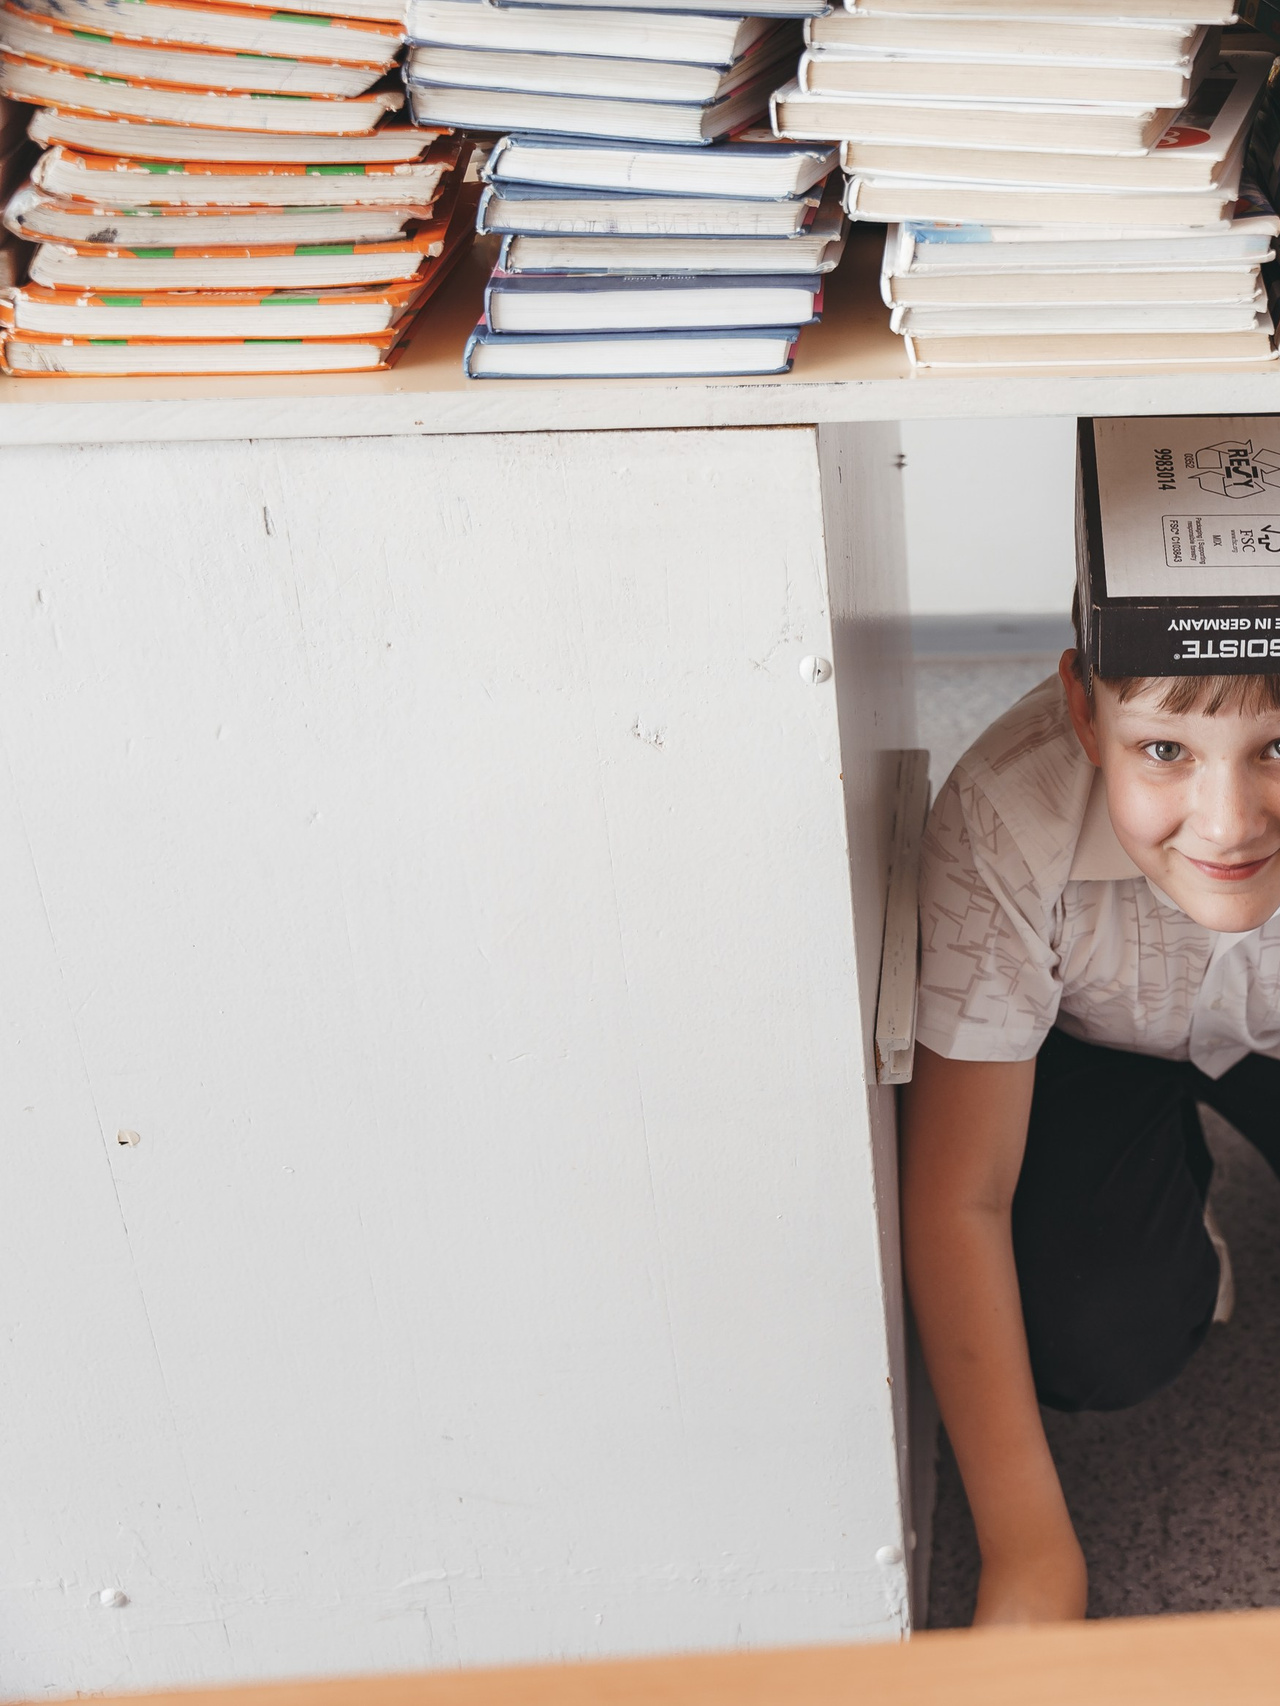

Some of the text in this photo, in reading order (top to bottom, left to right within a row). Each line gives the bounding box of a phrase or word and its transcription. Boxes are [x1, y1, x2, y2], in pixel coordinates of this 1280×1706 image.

[1154, 448, 1177, 491] 9983014
[1184, 453, 1195, 469] 0352
[1187, 521, 1196, 544] responsible
[1195, 517, 1204, 539] Packaging
[1171, 536, 1183, 563] C103843
[1212, 534, 1223, 547] MIX
[1239, 529, 1256, 553] FSC
[1198, 542, 1207, 565] Supporting
[1167, 618, 1252, 631] GERMANY
[1254, 617, 1272, 630] IN
